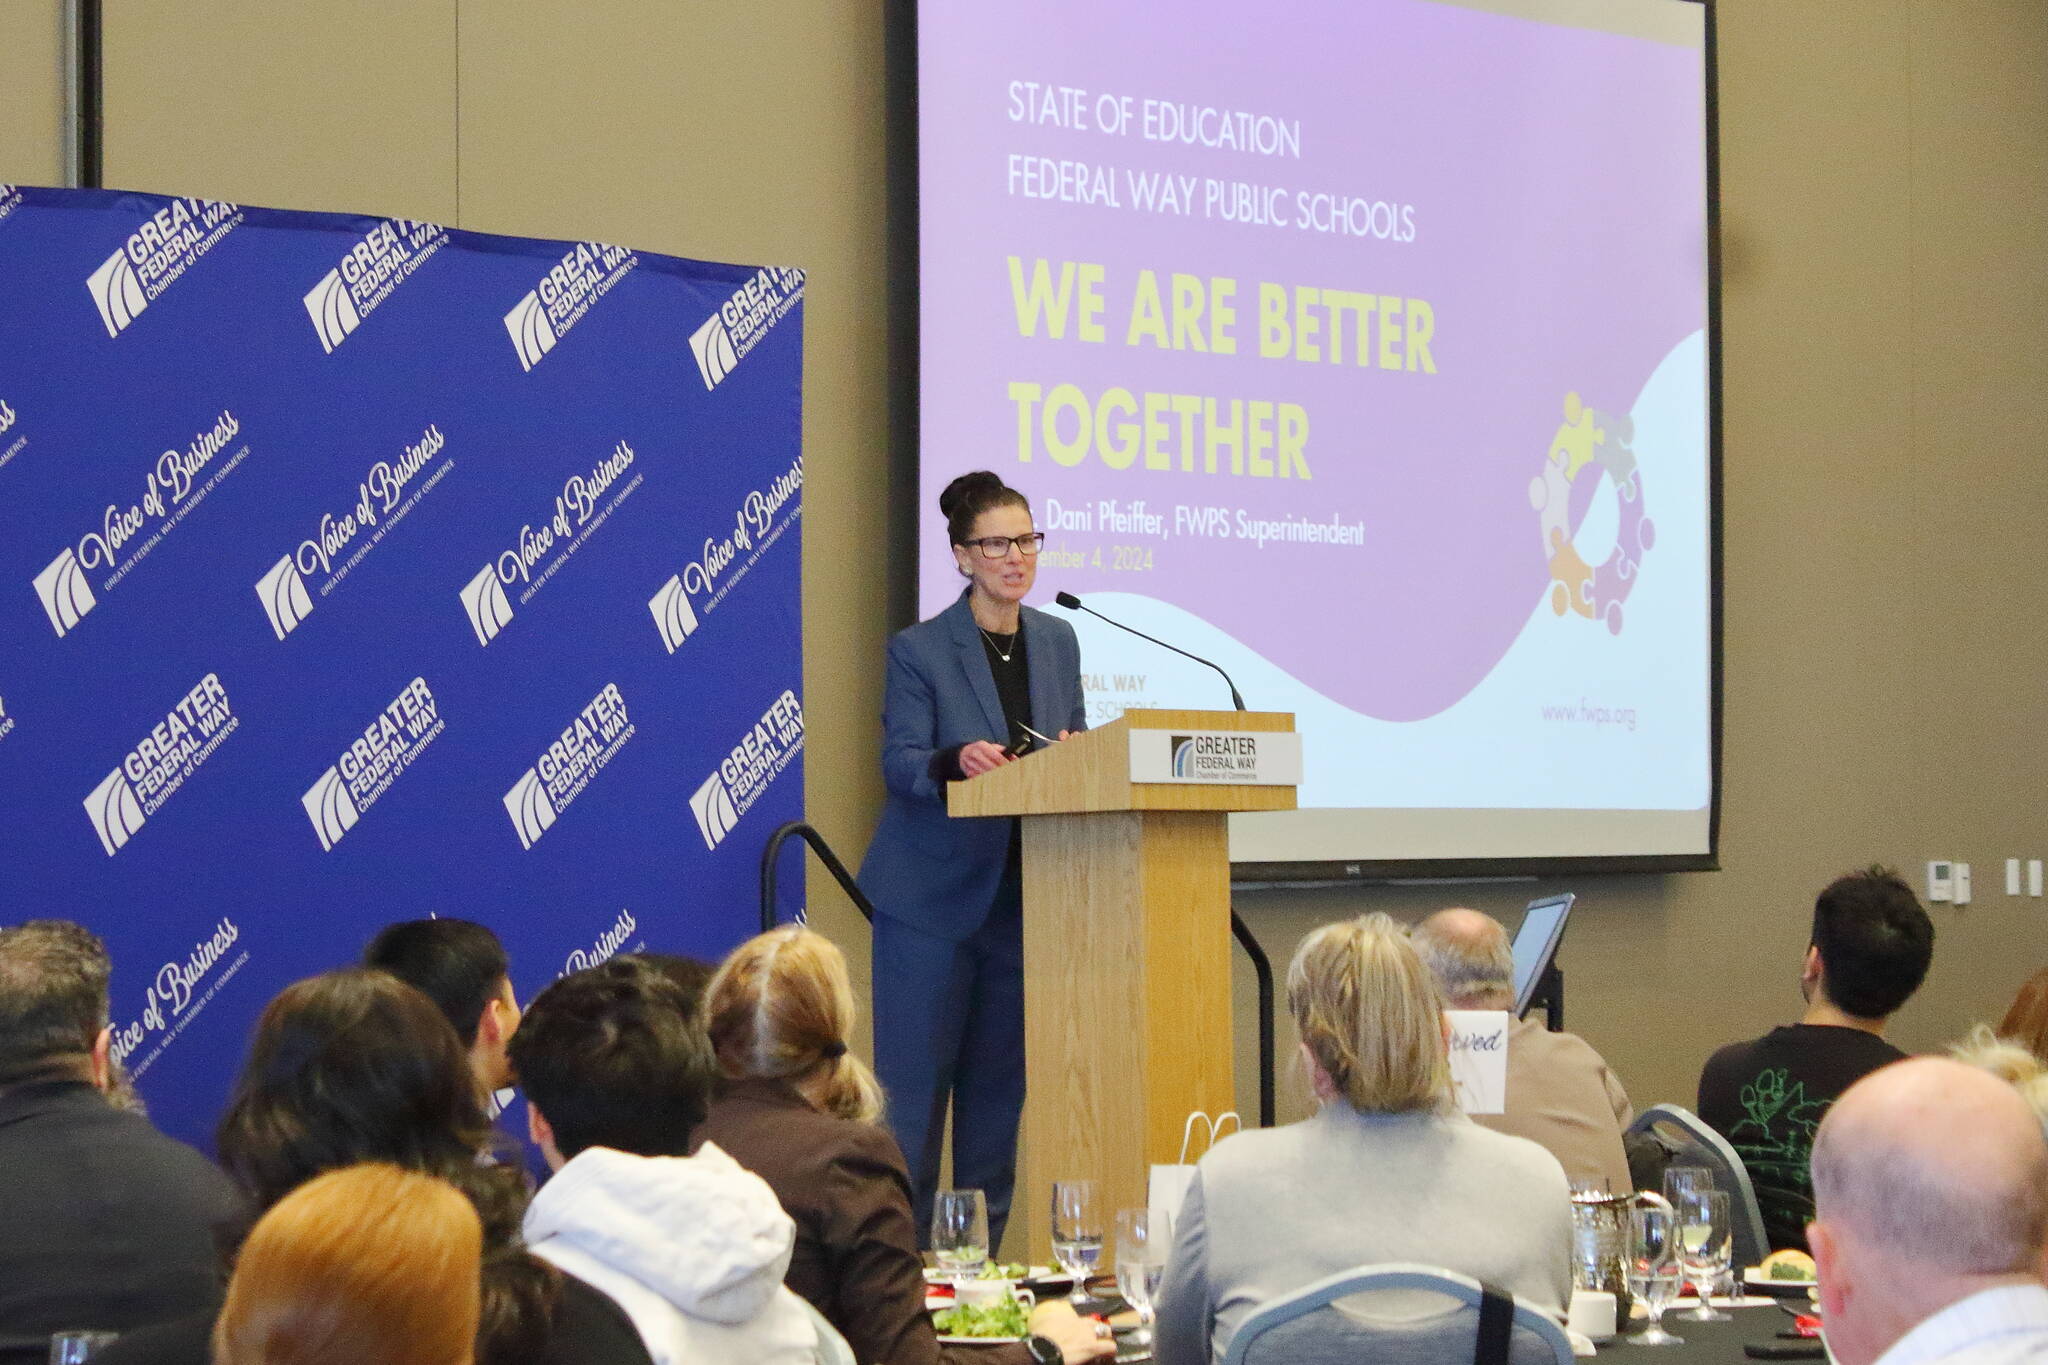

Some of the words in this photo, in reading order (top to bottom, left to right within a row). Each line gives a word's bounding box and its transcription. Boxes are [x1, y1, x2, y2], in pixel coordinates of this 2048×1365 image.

[1008, 80, 1087, 130] STATE
[1096, 94, 1133, 136] OF
[1144, 99, 1300, 158] EDUCATION
[1008, 154, 1120, 208] FEDERAL
[1127, 169, 1197, 216] WAY
[1206, 178, 1288, 227] PUBLIC
[1297, 191, 1416, 243] SCHOOLS
[137, 222, 204, 287] FEDERAL
[146, 261, 186, 300] Chamber
[186, 248, 196, 266] of
[195, 213, 245, 256] Commerce
[351, 242, 411, 305] FEDERAL
[359, 279, 395, 318] Chamber
[394, 267, 404, 284] of
[403, 233, 449, 275] Commerce
[548, 263, 605, 325] FEDERAL
[556, 300, 589, 338] Chamber
[588, 288, 598, 305] of
[596, 256, 638, 296] Commerce
[730, 289, 783, 347] FEDERAL
[737, 323, 768, 358] Chamber
[767, 312, 776, 327] of
[1006, 255, 1106, 343] WE
[1126, 269, 1237, 355] ARE
[1259, 281, 1438, 374] BETTER
[1008, 381, 1312, 480] TOGETHER
[78, 505, 143, 569] Voice
[143, 473, 165, 517] of
[156, 409, 239, 504] Business
[296, 512, 357, 576] Voice
[357, 483, 377, 526] of
[368, 423, 444, 514] Business
[498, 524, 554, 584] Voice
[553, 496, 572, 537] of
[564, 439, 634, 526] Business
[1047, 498, 1092, 531] Dani
[1099, 499, 1169, 541] Pfeiffer,
[1176, 506, 1231, 538] FWPS
[1236, 508, 1365, 550] Superintendent
[683, 537, 735, 595] Voice
[734, 510, 752, 550] of
[1038, 542, 1086, 569] ember
[1092, 549, 1107, 573] 4,
[1113, 546, 1153, 572] 2024
[125, 672, 225, 782] GREATER
[340, 676, 432, 780] GREATER
[1113, 674, 1147, 693] WAY
[1542, 696, 1636, 731] www.fwps.org
[135, 733, 201, 803] FEDERAL
[197, 695, 230, 738] WAY
[144, 772, 184, 816] Chamber
[183, 758, 194, 777] of
[192, 717, 239, 766] Commerce
[349, 734, 410, 800] FEDERAL
[406, 699, 437, 739] WAY
[357, 772, 395, 813] Chamber
[394, 759, 403, 776] of
[402, 719, 445, 766] Commerce
[538, 682, 624, 781] GREATER
[547, 738, 604, 801] FEDERAL
[600, 704, 628, 743] WAY
[555, 774, 589, 814] Chamber
[588, 761, 598, 778] of
[596, 723, 636, 769] Commerce
[721, 689, 800, 785] GREATER
[729, 742, 781, 804] FEDERAL
[778, 710, 805, 747] WAY
[1196, 736, 1256, 755] GREATER
[1196, 756, 1234, 769] FEDERAL
[1237, 757, 1257, 770] WAY
[737, 778, 769, 816] Chamber
[767, 766, 776, 782] of
[107, 1022, 144, 1068] oice
[144, 987, 166, 1030] of
[156, 917, 238, 1016] Business
